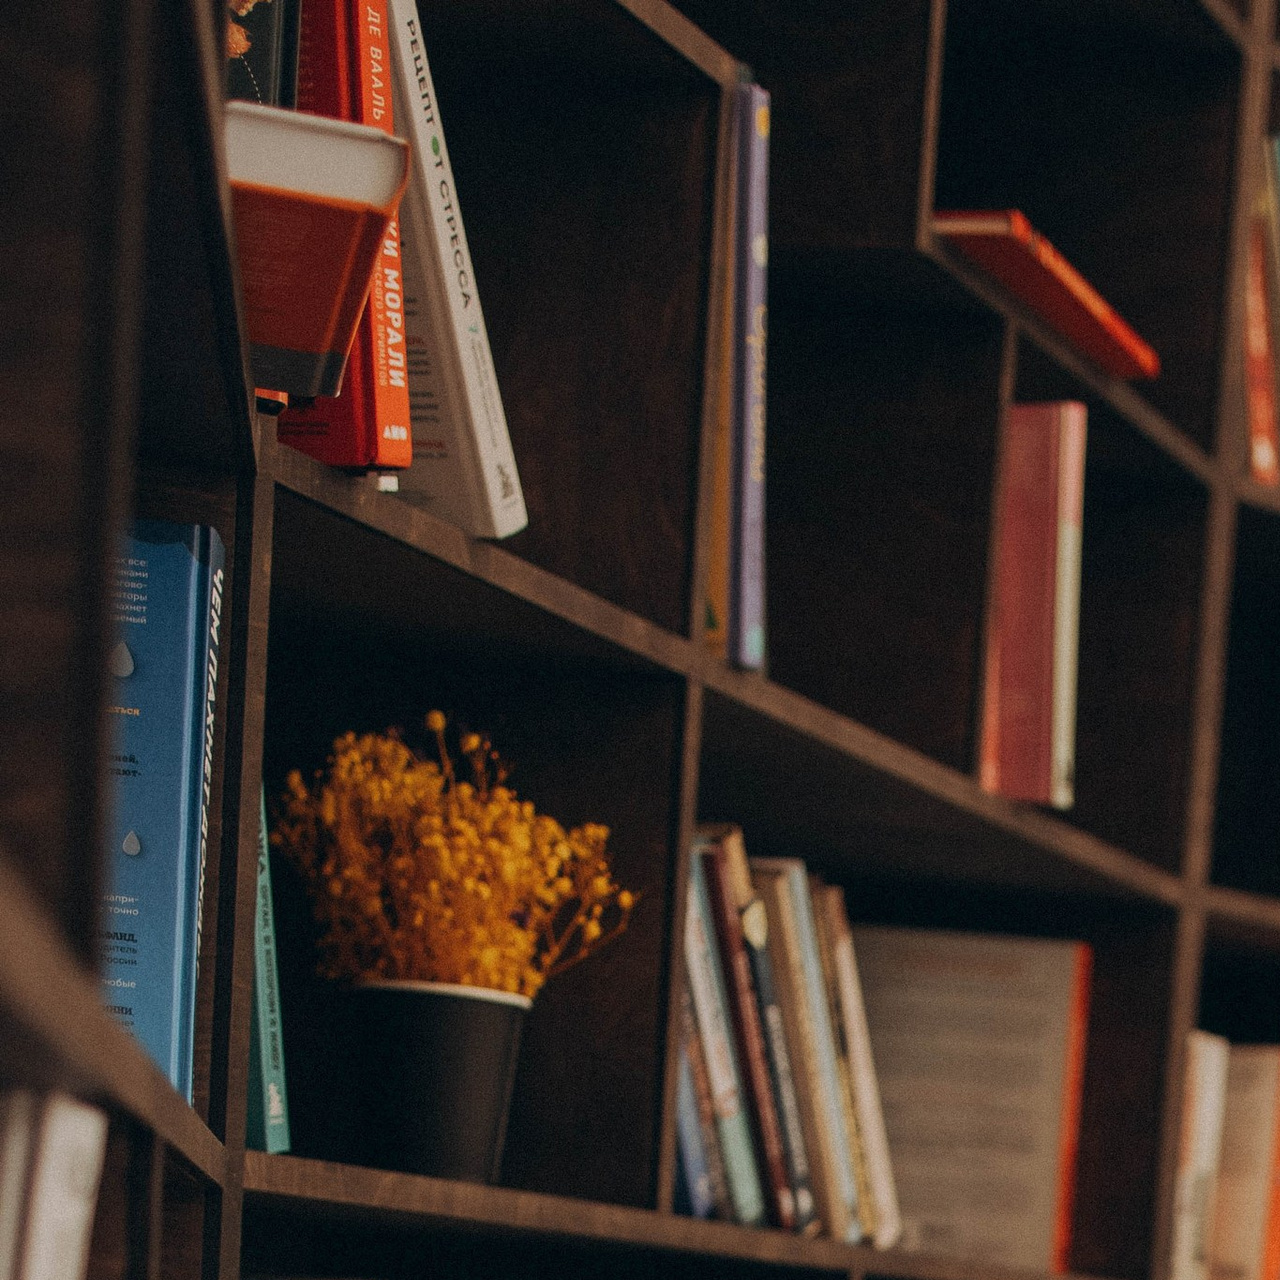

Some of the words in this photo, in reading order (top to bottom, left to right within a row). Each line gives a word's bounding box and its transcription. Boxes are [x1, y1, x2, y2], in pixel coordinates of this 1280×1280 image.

[367, 6, 381, 38] ДЕ
[369, 46, 386, 121] ВААЛЬ
[406, 19, 436, 126] РЕЦЕПТ
[439, 179, 470, 309] СТРЕССА
[383, 267, 406, 388] МОРАЛИ
[211, 568, 224, 646] ЧЕМ
[202, 648, 218, 806] ПАХНЕТ
